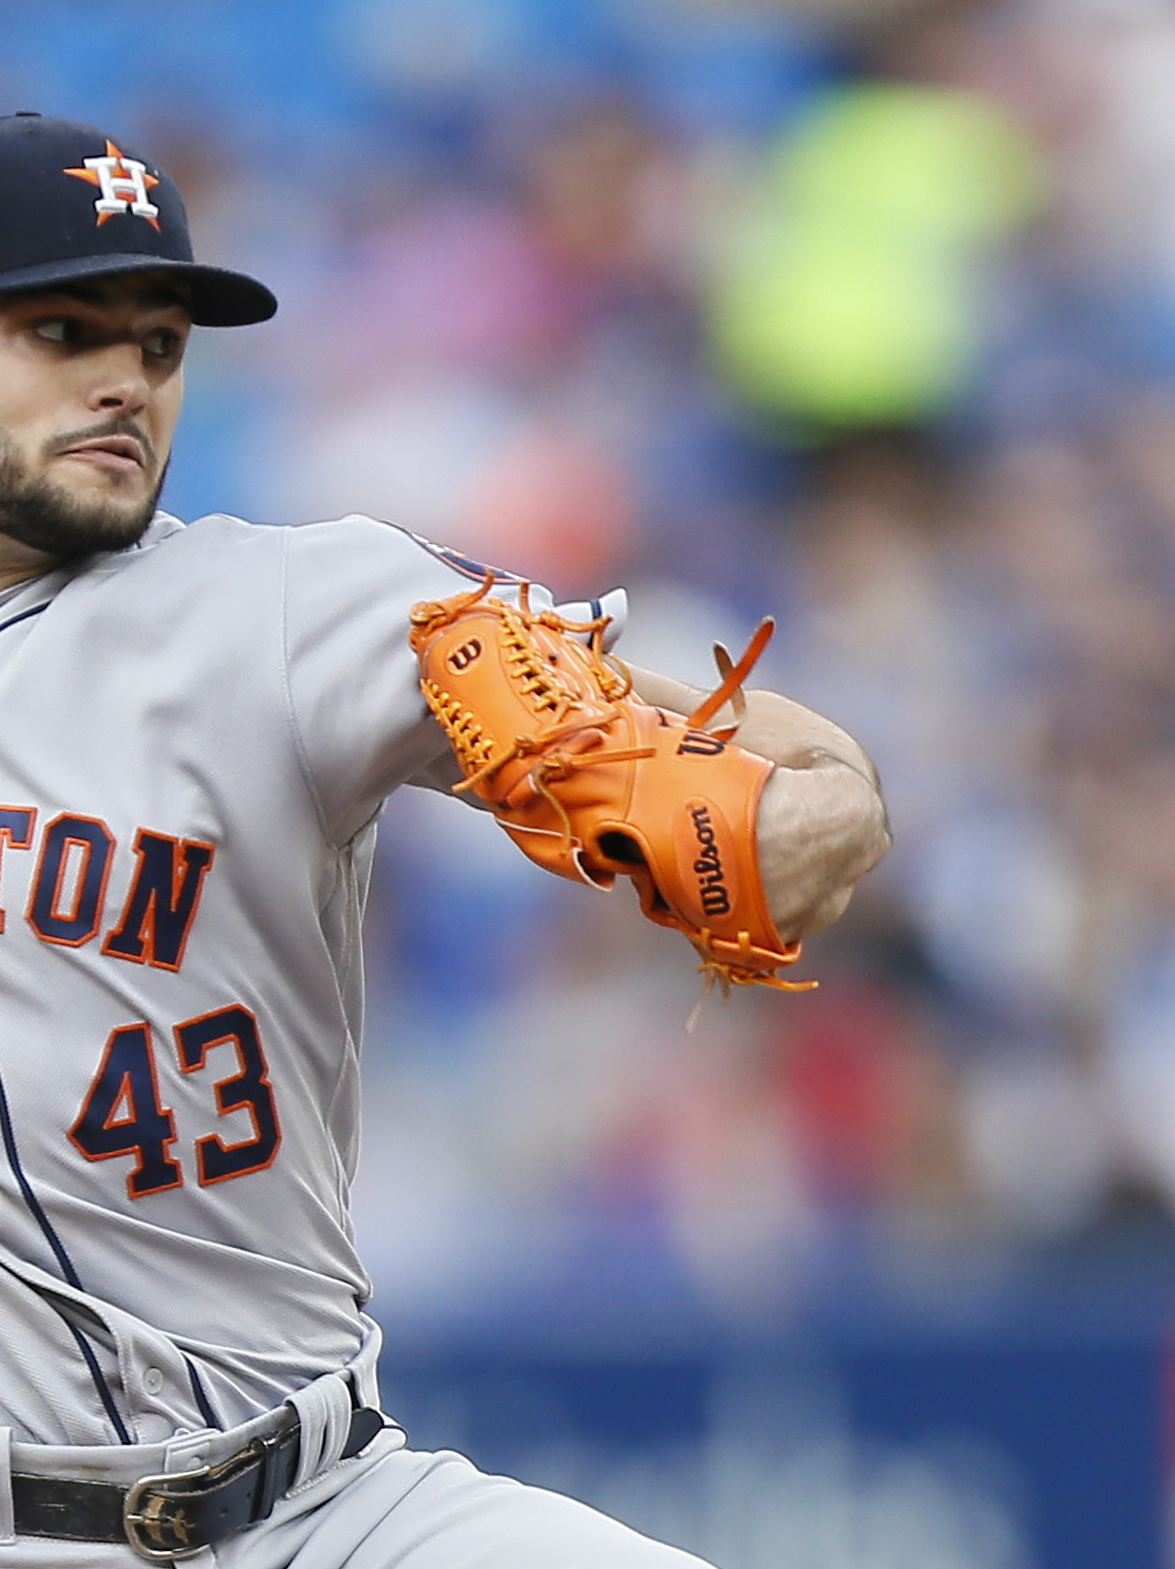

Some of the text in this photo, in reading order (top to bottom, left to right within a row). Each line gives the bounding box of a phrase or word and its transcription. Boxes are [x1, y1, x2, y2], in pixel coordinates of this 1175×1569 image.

[83, 156, 159, 218] H
[690, 805, 730, 916] Wilson
[66, 1003, 283, 1200] 43
